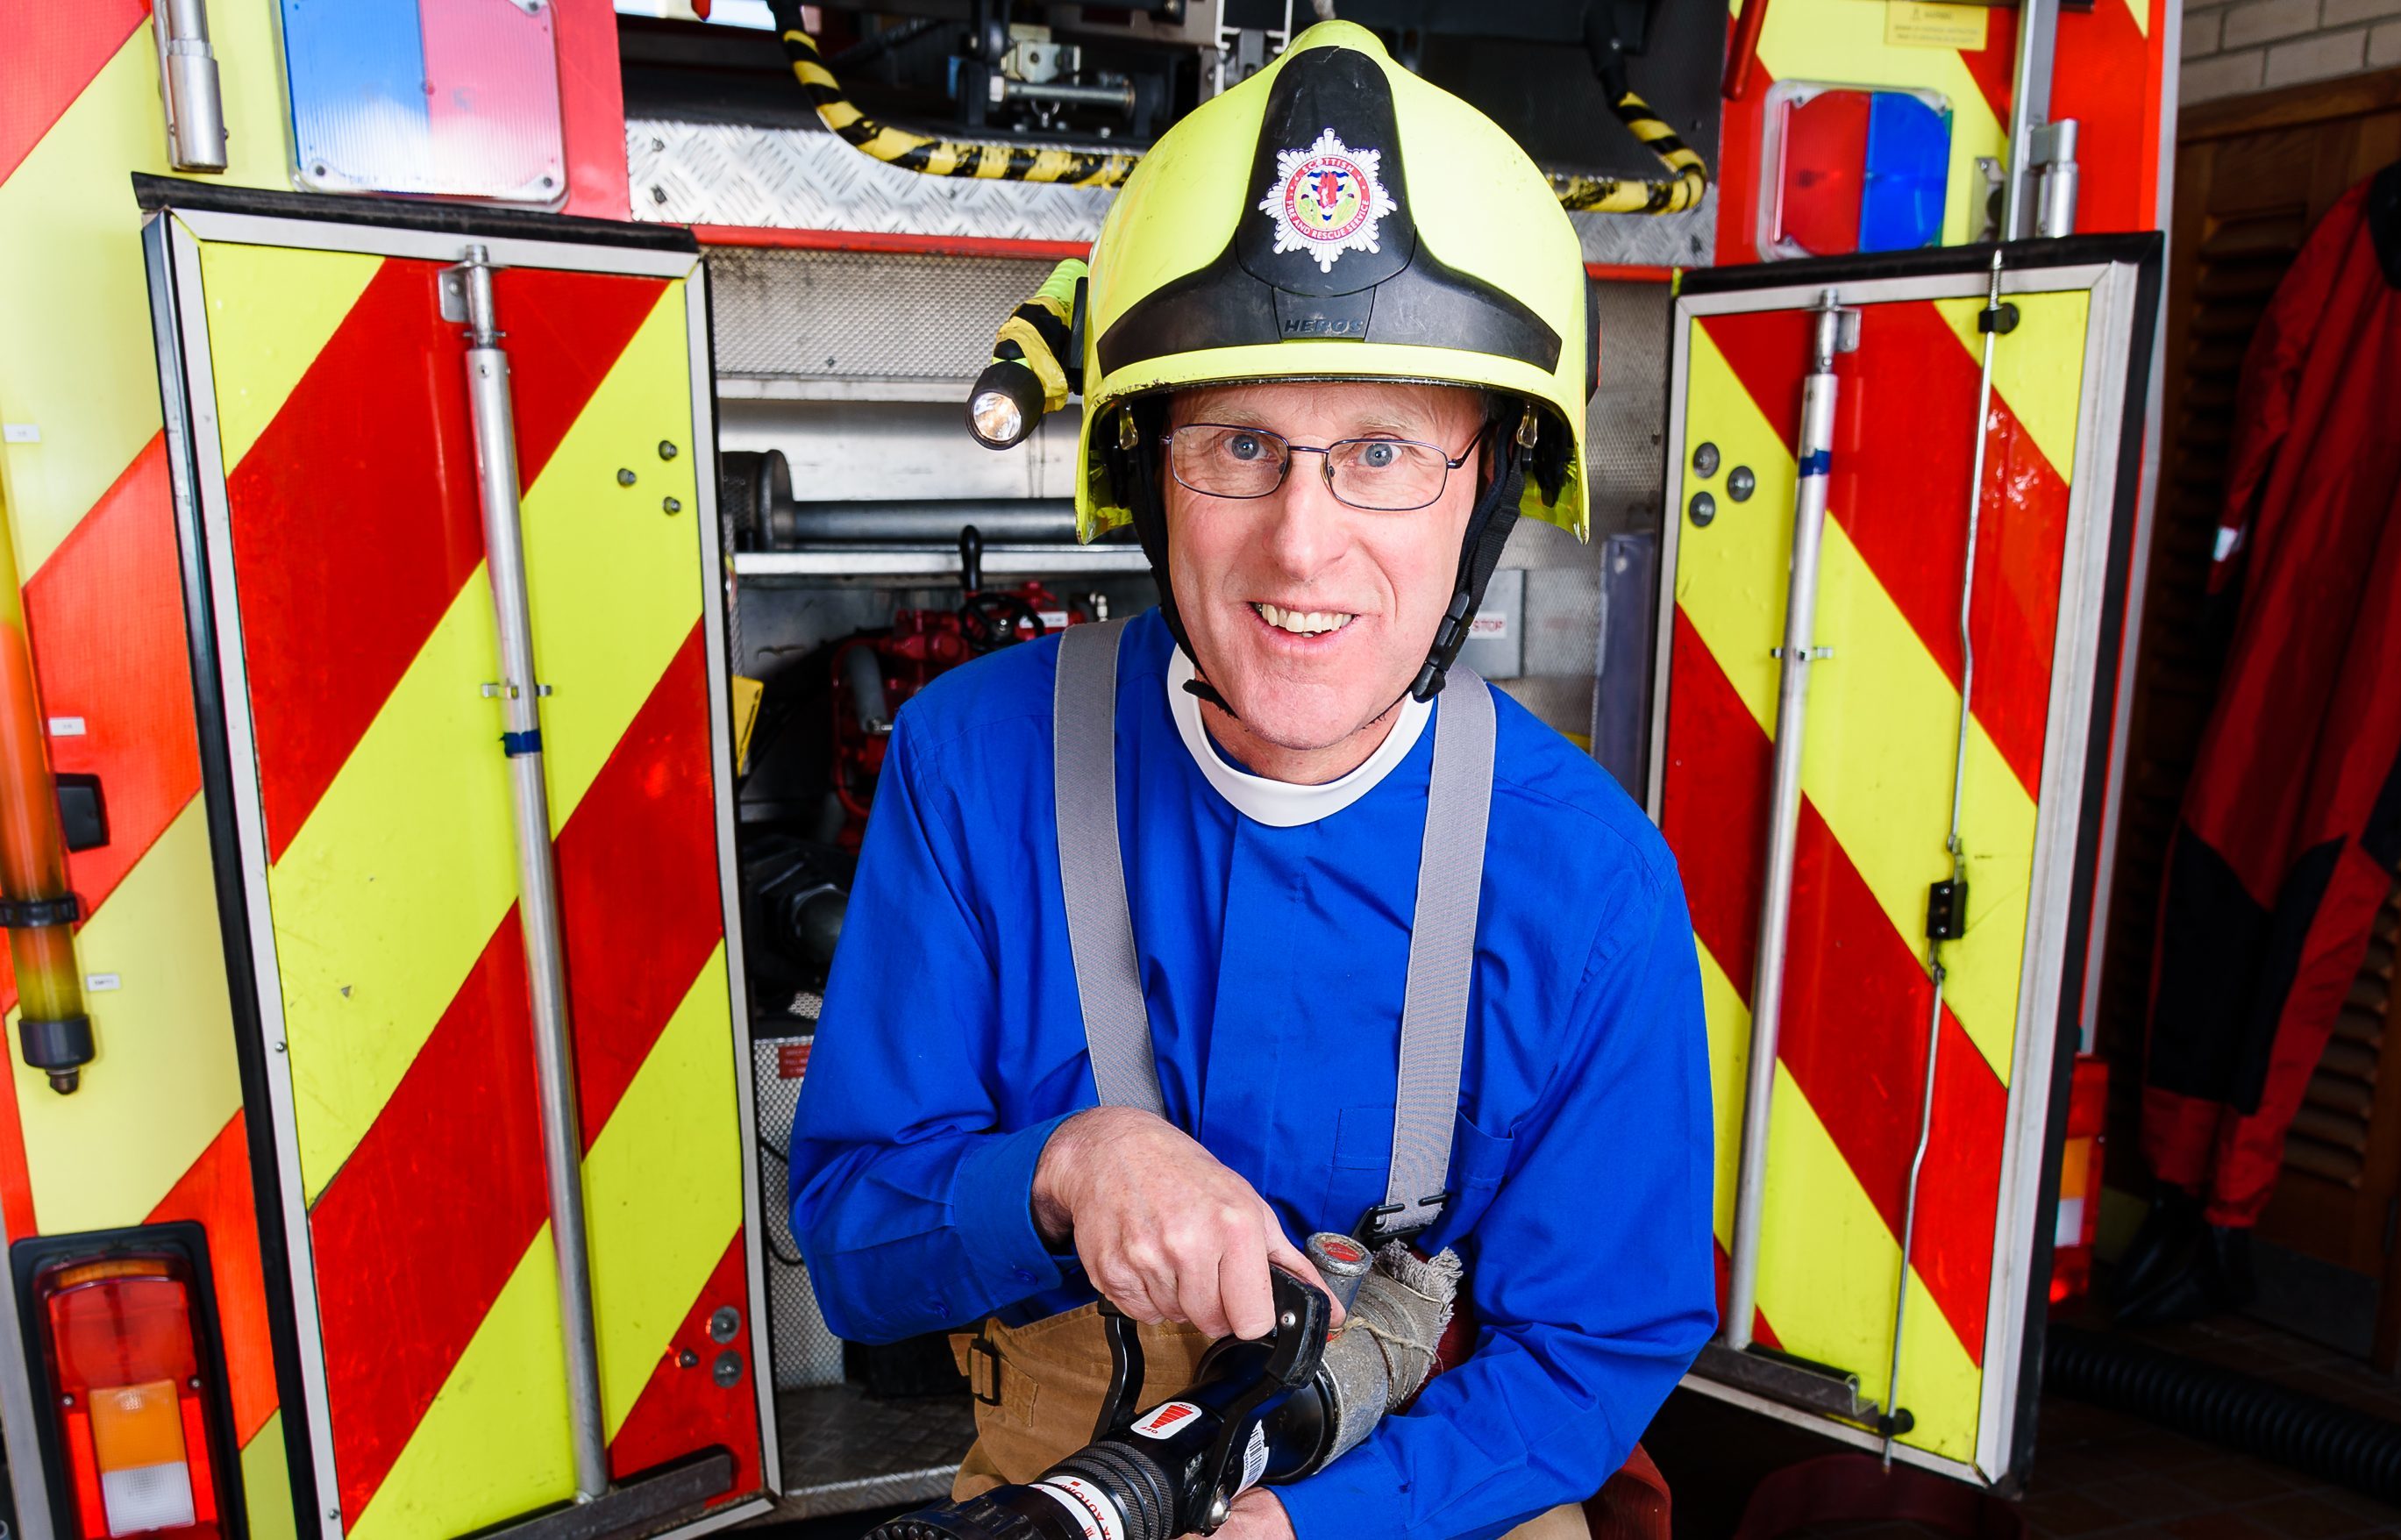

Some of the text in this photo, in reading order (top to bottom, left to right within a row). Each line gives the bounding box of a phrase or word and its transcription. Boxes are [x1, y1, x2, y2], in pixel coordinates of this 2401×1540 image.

[1302, 158, 1354, 173] SCOTTISH
[1286, 199, 1369, 240] FIRE AND RESCUE SERVICE
[1472, 618, 1504, 631] STOP
